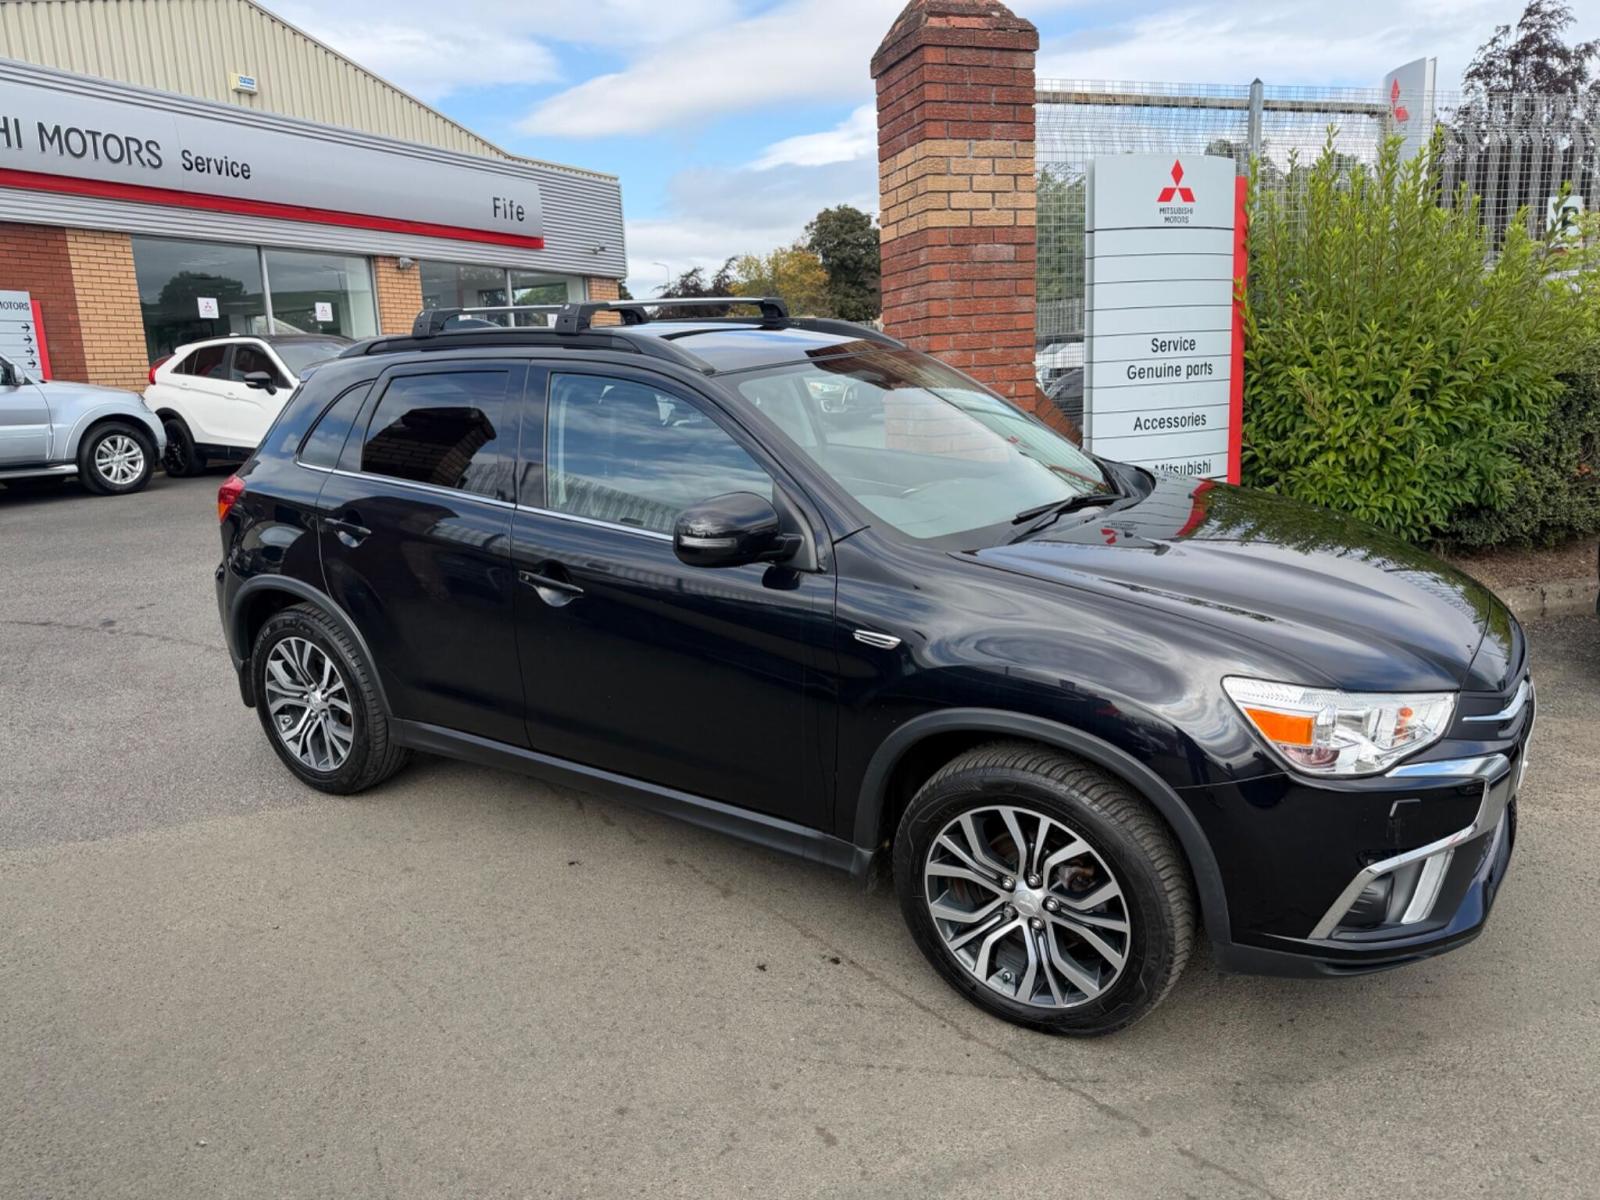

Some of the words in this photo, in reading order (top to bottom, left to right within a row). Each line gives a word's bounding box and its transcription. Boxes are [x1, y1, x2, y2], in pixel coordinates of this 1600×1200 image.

[37, 121, 163, 169] MOTORS
[181, 149, 251, 179] Service
[493, 197, 525, 222] Fife
[1159, 207, 1193, 215] MITSUBISHI
[1164, 216, 1189, 224] MOTORS
[1151, 337, 1196, 353] Service
[1127, 363, 1182, 380] Genuine
[1186, 362, 1213, 379] parts
[1133, 412, 1207, 431] Accessories
